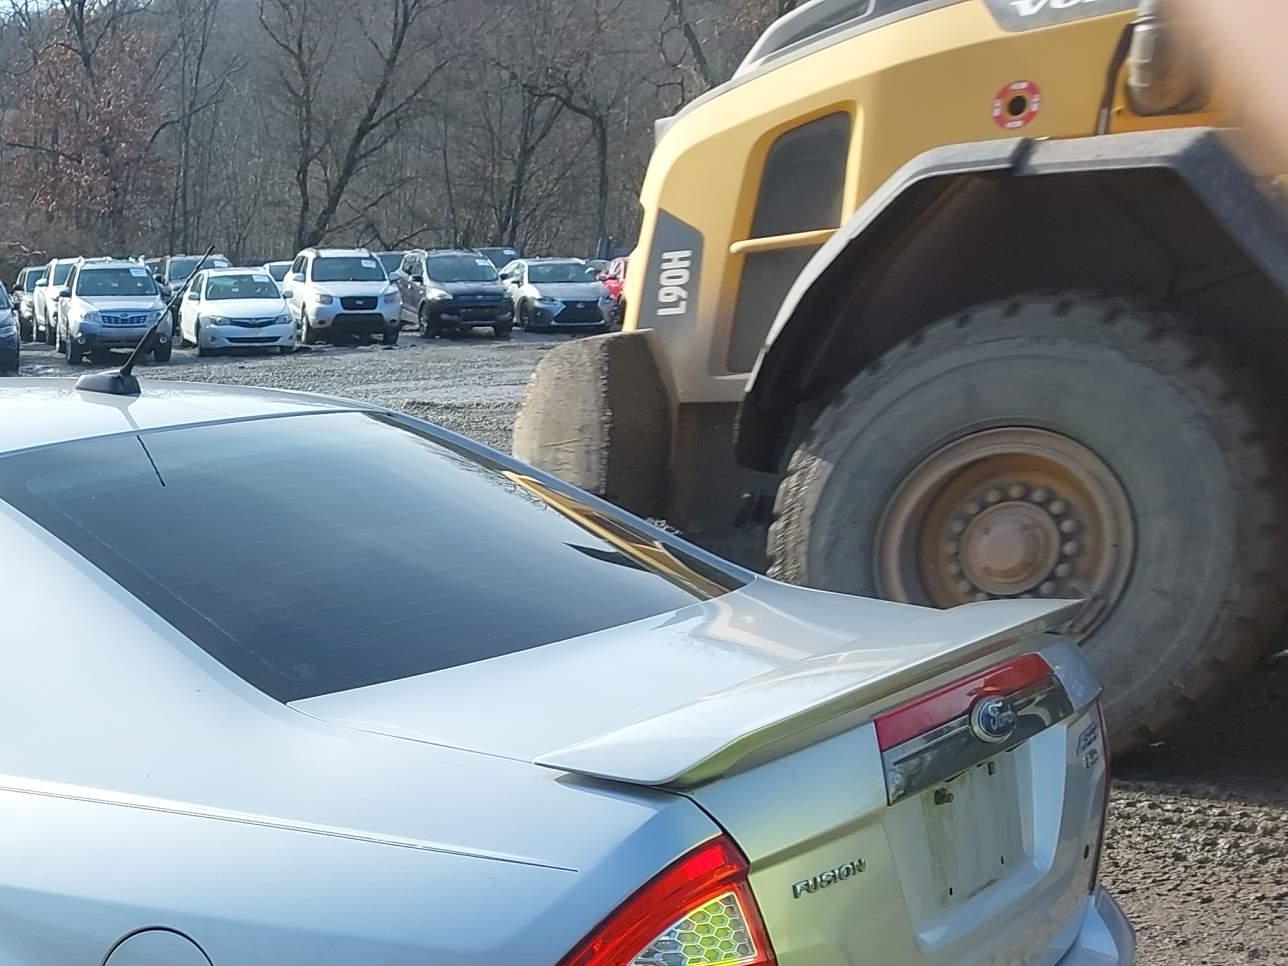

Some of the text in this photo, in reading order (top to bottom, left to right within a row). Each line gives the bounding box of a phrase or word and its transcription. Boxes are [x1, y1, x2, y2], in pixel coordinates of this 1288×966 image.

[656, 250, 693, 316] L90H
[989, 701, 1016, 730] Ford
[792, 858, 866, 899] FUSION
